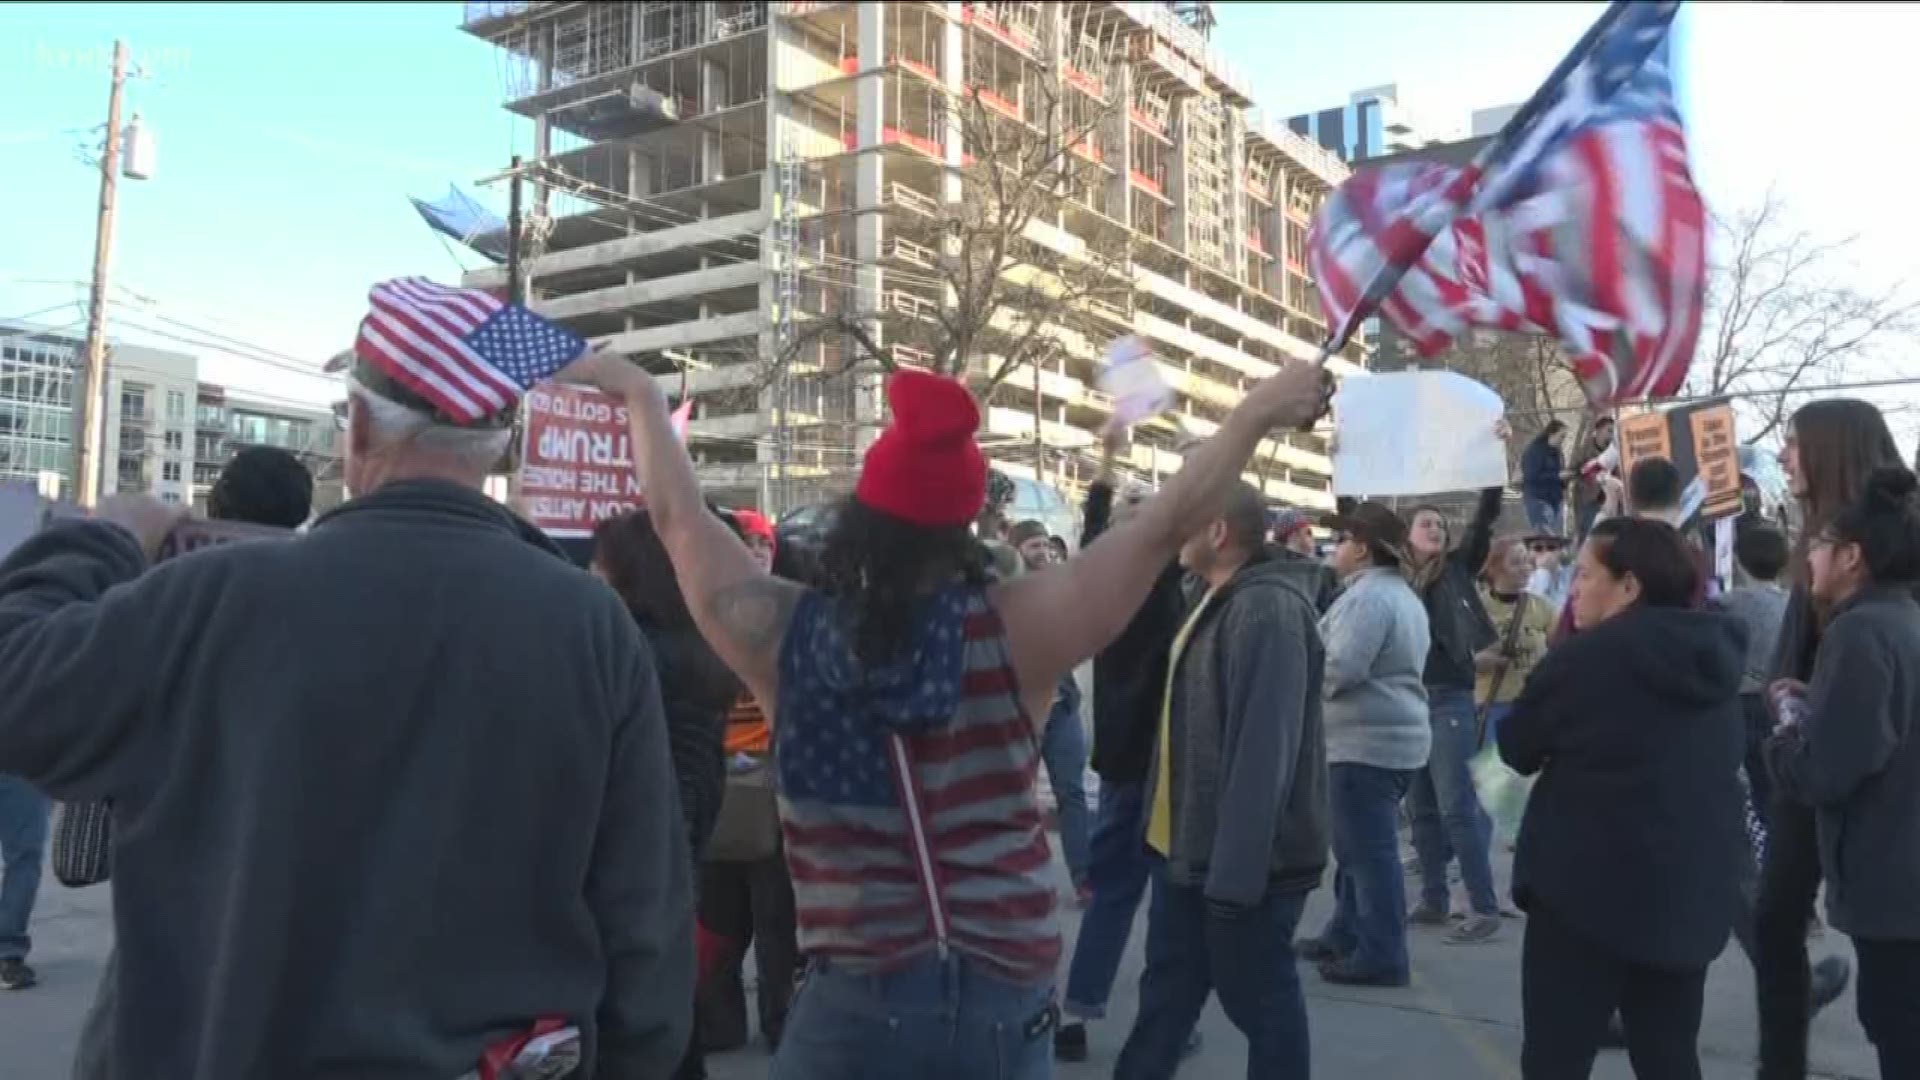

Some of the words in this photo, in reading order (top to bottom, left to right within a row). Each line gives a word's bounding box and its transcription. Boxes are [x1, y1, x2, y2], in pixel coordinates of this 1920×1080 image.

[552, 396, 573, 418] TO
[574, 399, 612, 424] GOT
[614, 406, 629, 425] S
[537, 425, 633, 466] TRUMP
[579, 470, 620, 494] THE
[625, 474, 641, 496] N
